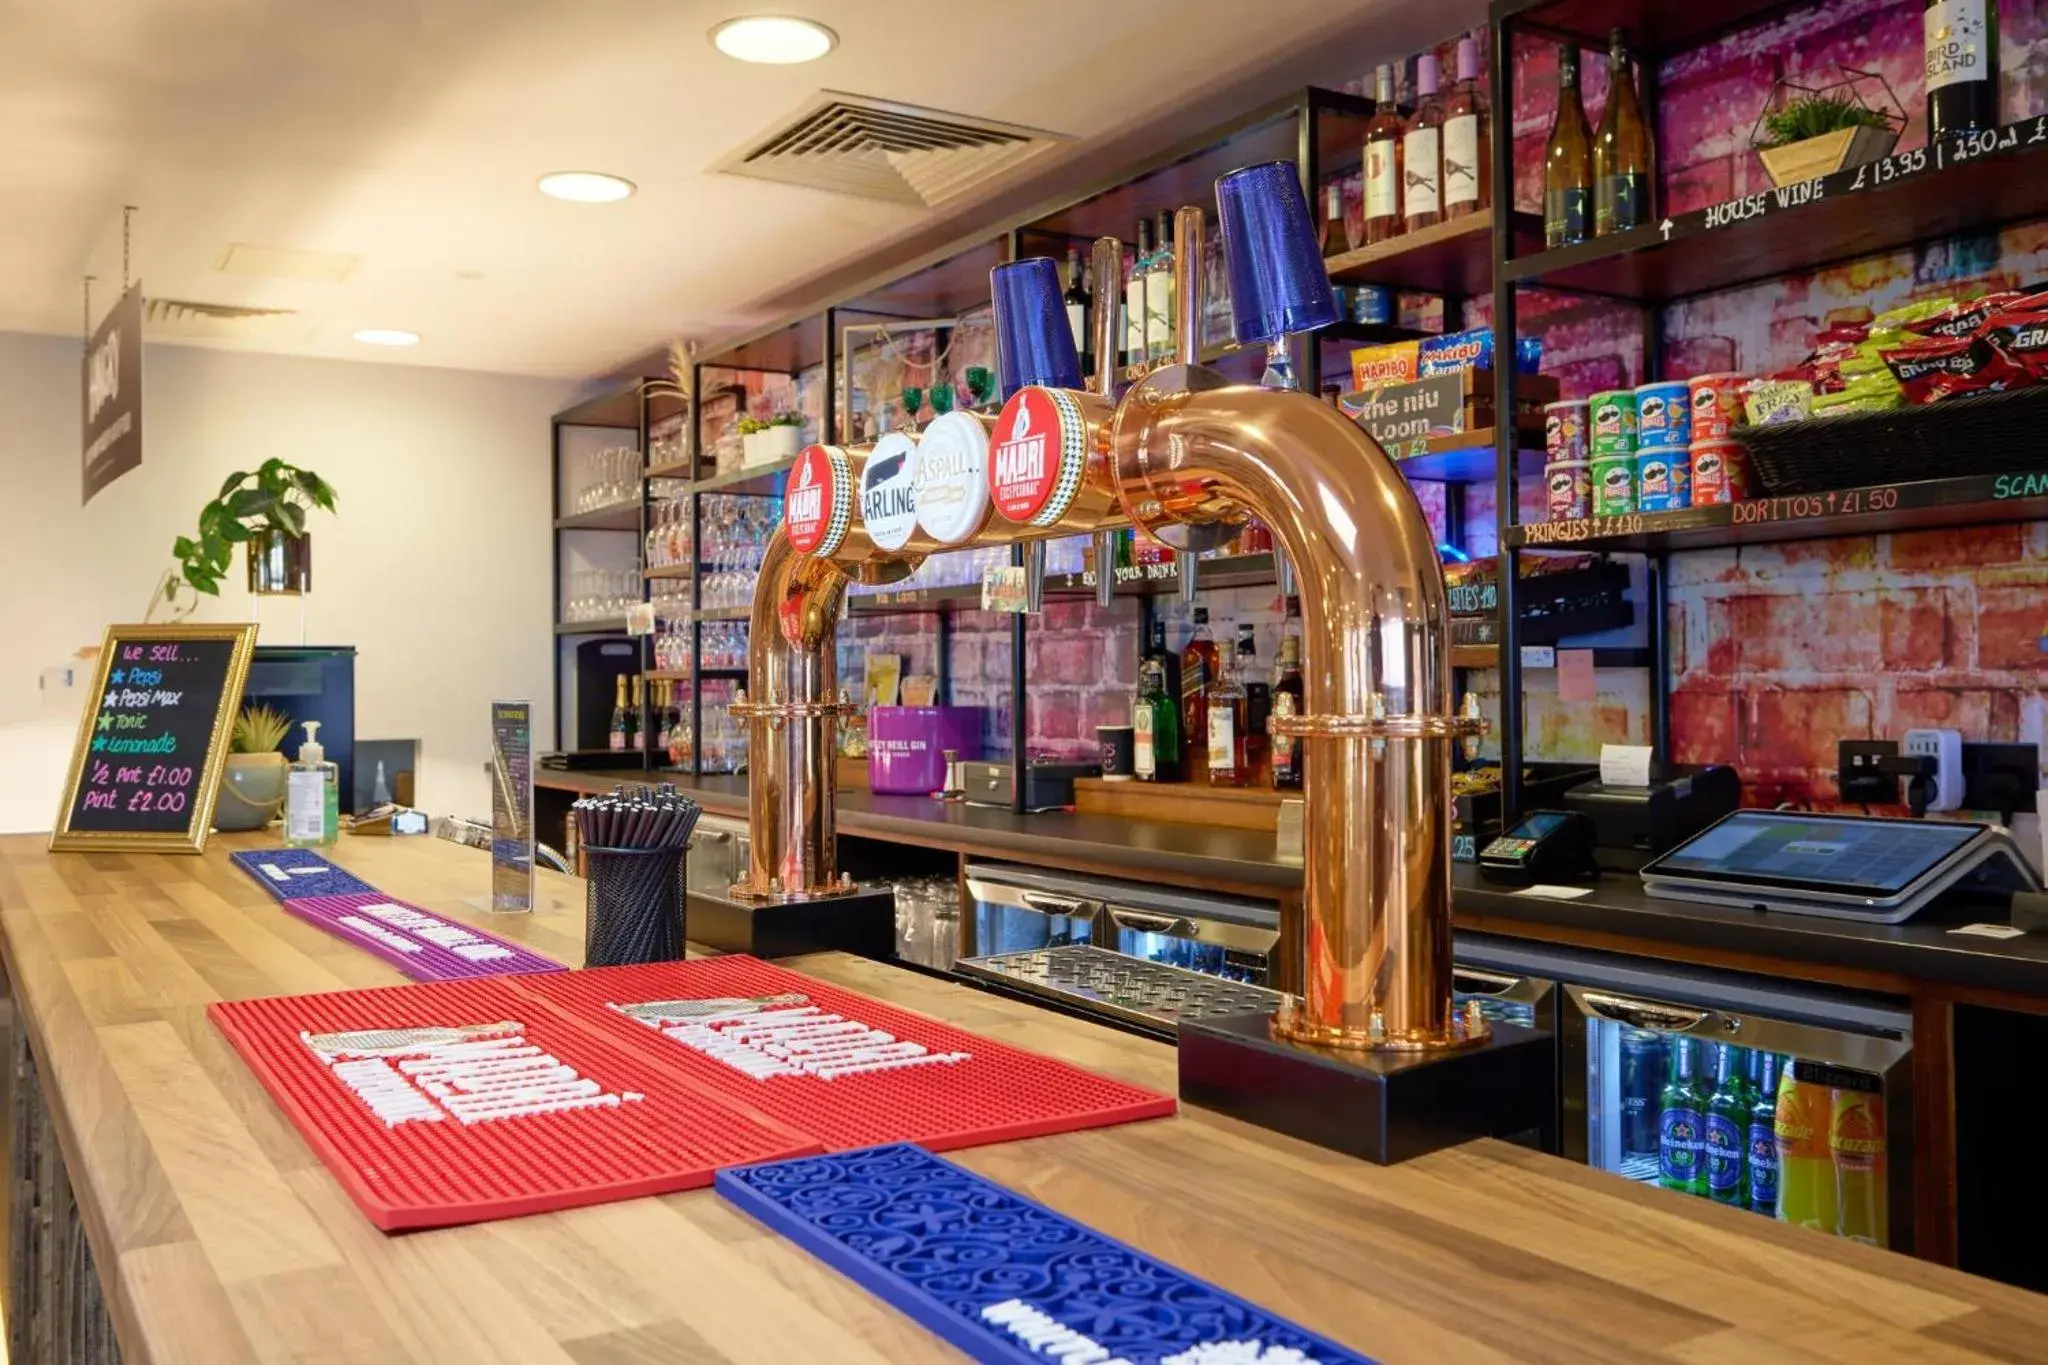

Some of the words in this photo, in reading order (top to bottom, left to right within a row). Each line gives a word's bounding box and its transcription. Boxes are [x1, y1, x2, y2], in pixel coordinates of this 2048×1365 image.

[1926, 42, 1960, 64] BIRD
[1705, 195, 1766, 229] HOUSE
[1776, 177, 1824, 209] WINE
[1849, 149, 1925, 191] £13.95
[1953, 126, 2018, 161] 250ml
[1359, 358, 1409, 382] HARIBO
[1403, 388, 1439, 413] niu
[1371, 418, 1430, 441] Loom
[865, 485, 916, 521] ARLING
[1841, 488, 1898, 513] £1.50
[1147, 562, 1178, 580] DRINK
[128, 666, 163, 687] Pepsi
[118, 688, 151, 707] Pepsi
[107, 731, 177, 754] Lemonade
[147, 764, 193, 787] £1.00
[127, 789, 186, 813] £2.00
